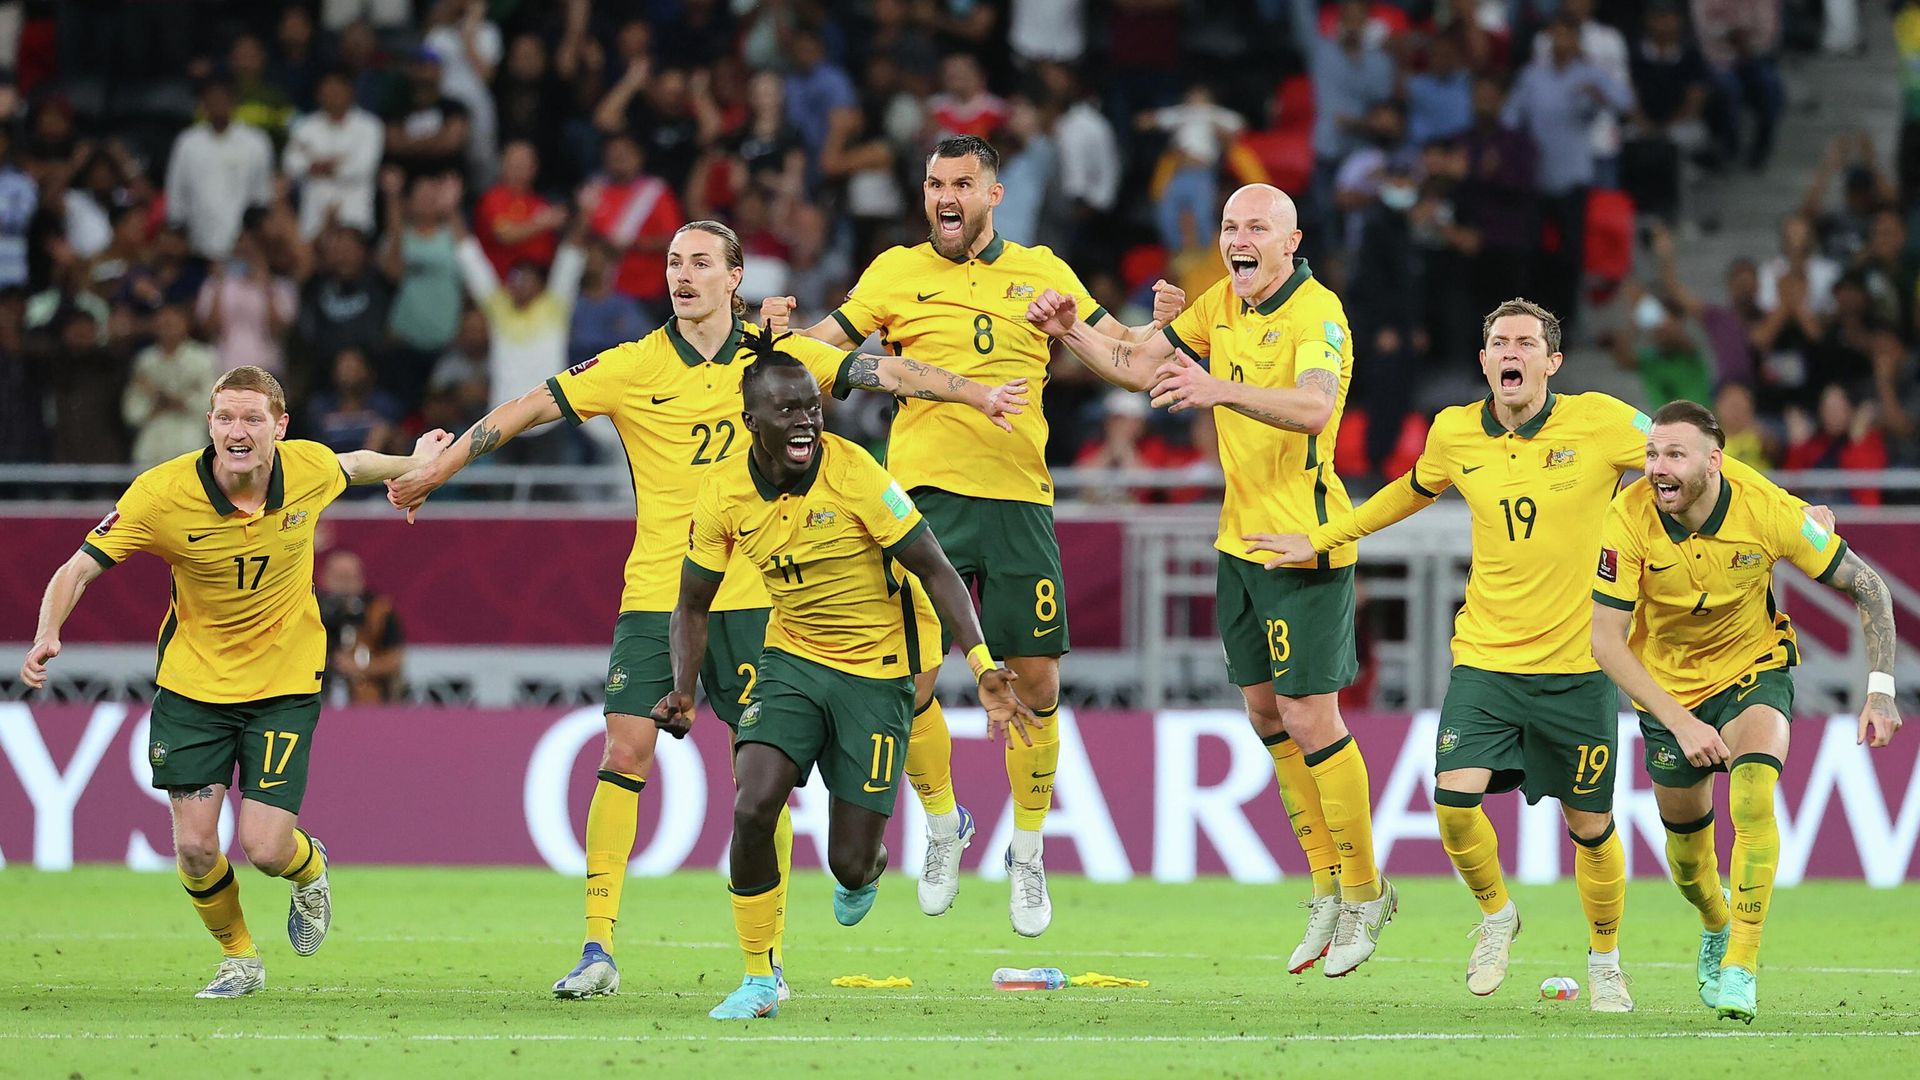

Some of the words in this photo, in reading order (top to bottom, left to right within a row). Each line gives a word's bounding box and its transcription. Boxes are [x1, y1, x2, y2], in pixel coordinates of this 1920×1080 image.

[973, 314, 994, 354] 8
[691, 420, 735, 465] 22
[1499, 496, 1537, 541] 19
[233, 555, 270, 590] 17
[771, 555, 803, 584] 11
[1034, 578, 1058, 623] 8
[1690, 592, 1712, 617] 6
[1265, 618, 1291, 663] 13
[262, 730, 300, 775] 17
[869, 733, 895, 783] 11
[1575, 743, 1610, 785] 19
[0, 700, 235, 872] YS
[909, 779, 932, 791] US
[1296, 825, 1312, 837] US
[1336, 842, 1353, 850] US
[586, 887, 609, 897] AUS
[1475, 890, 1497, 901] AUS
[1737, 901, 1762, 913] AUS
[1596, 928, 1617, 936] AUS
